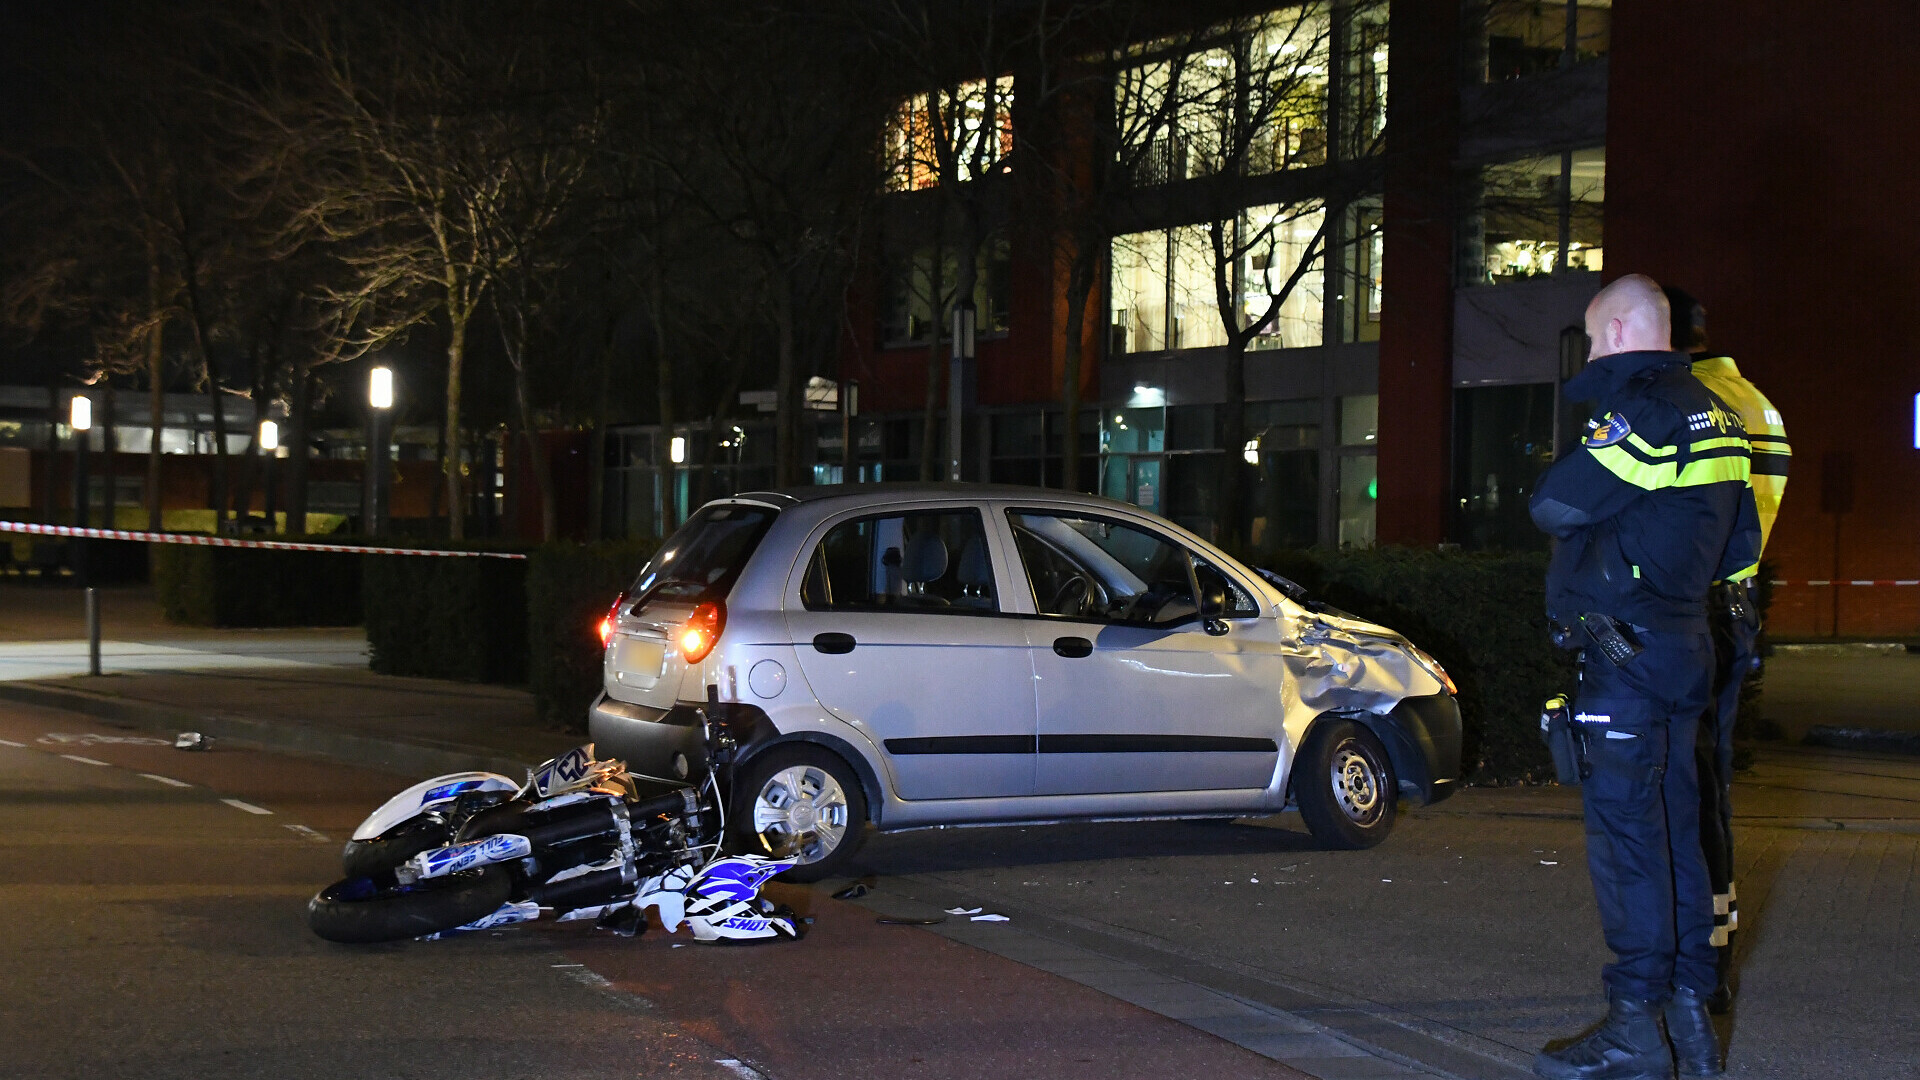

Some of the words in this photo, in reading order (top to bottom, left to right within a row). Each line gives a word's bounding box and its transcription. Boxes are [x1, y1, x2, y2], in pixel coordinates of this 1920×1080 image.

[480, 835, 504, 854] FULL
[448, 849, 478, 873] SEND
[723, 917, 770, 932] SHOT
